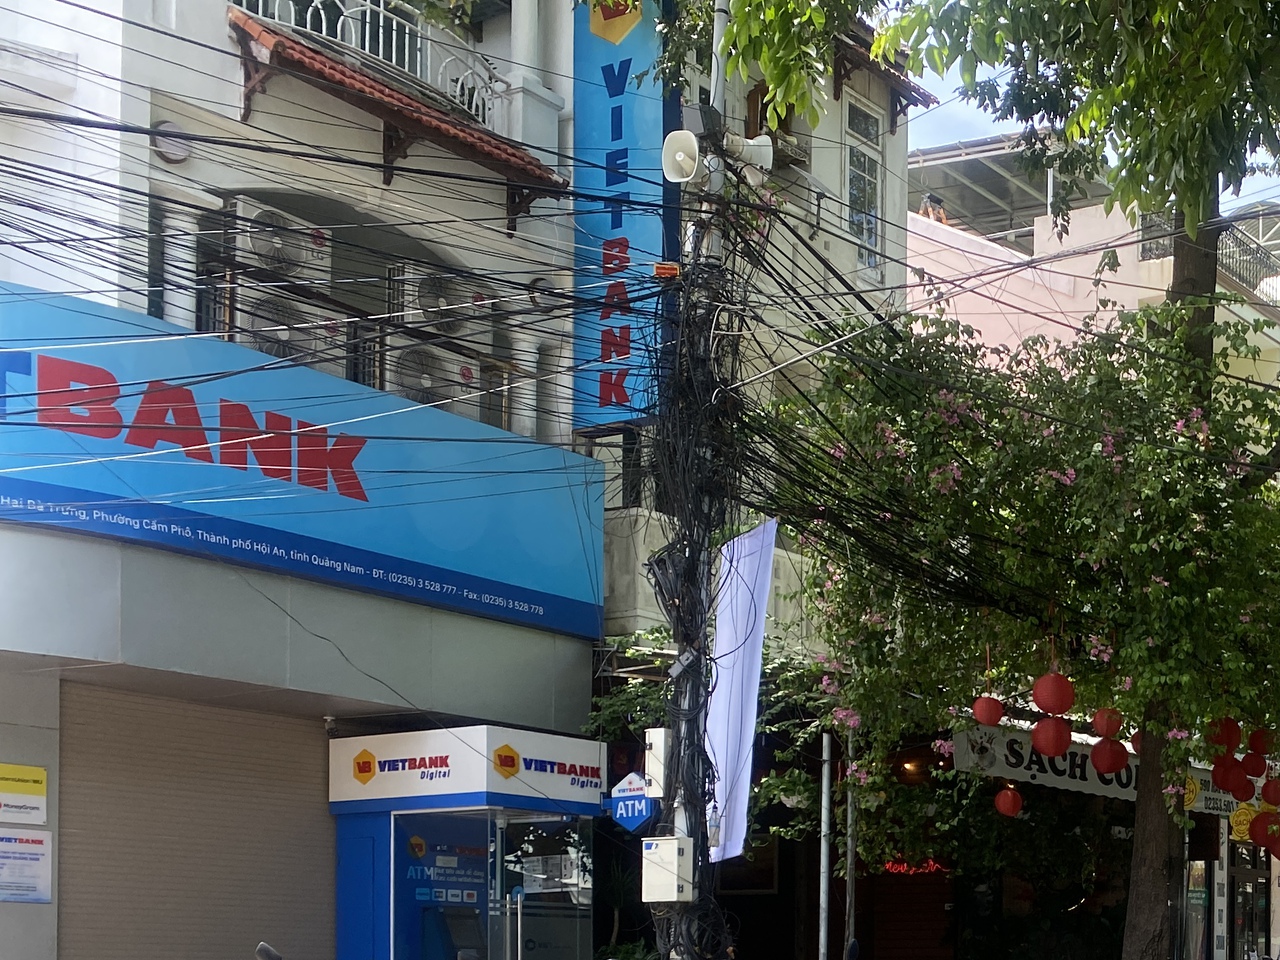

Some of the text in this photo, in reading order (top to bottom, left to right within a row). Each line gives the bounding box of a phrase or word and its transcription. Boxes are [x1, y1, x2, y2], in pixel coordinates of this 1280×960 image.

[93, 509, 140, 530] Phường
[197, 529, 230, 546] Thành
[232, 536, 252, 553] phố
[254, 541, 271, 556] Hội
[272, 546, 289, 561] An,
[311, 553, 342, 573] Quảng
[343, 561, 365, 576] Nam
[388, 571, 417, 588] (0235)
[417, 578, 423, 589] 3
[424, 580, 441, 592] 528
[442, 584, 457, 595] 777
[463, 588, 480, 602] Fax:
[481, 592, 507, 608] (0235)
[508, 598, 513, 610] 3
[514, 601, 529, 612] 528
[530, 604, 544, 616] 778
[377, 754, 451, 774] VIETBANK
[522, 757, 601, 780] VIETBANK
[420, 769, 451, 781] Digital
[616, 799, 647, 818] ATM
[406, 865, 434, 881] ATM
